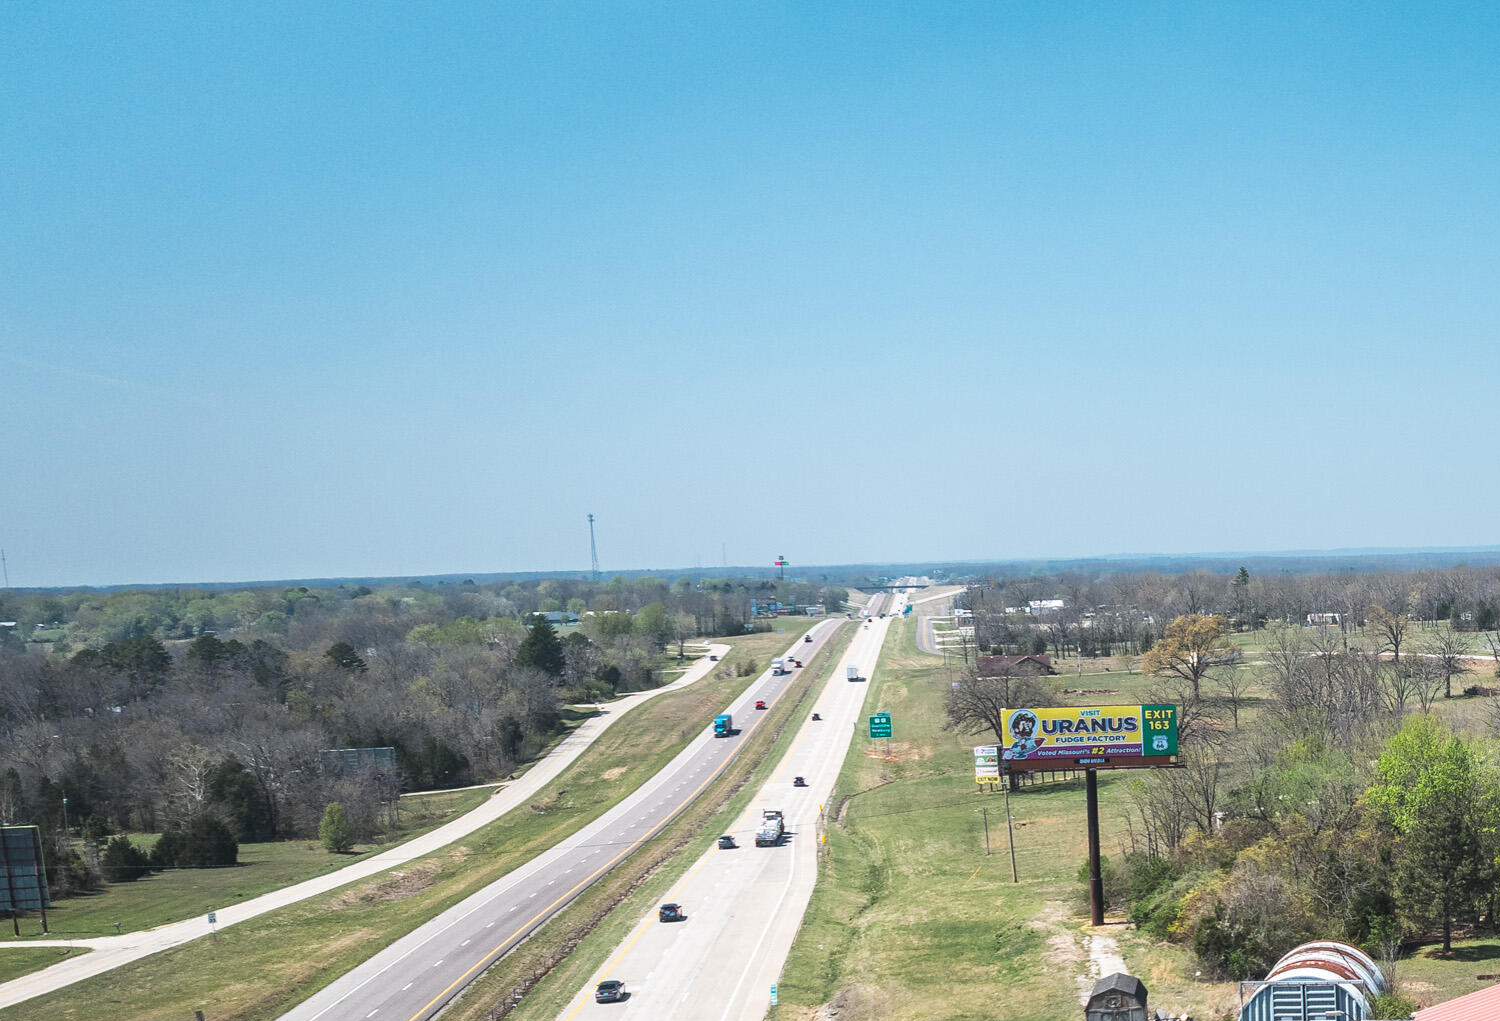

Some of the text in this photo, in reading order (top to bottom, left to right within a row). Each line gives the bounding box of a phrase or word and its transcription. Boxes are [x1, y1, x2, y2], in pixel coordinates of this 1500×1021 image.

[1144, 709, 1174, 719] EXIT
[1041, 717, 1138, 734] URANUS
[1148, 720, 1170, 730] 163
[1091, 747, 1105, 755] #2
